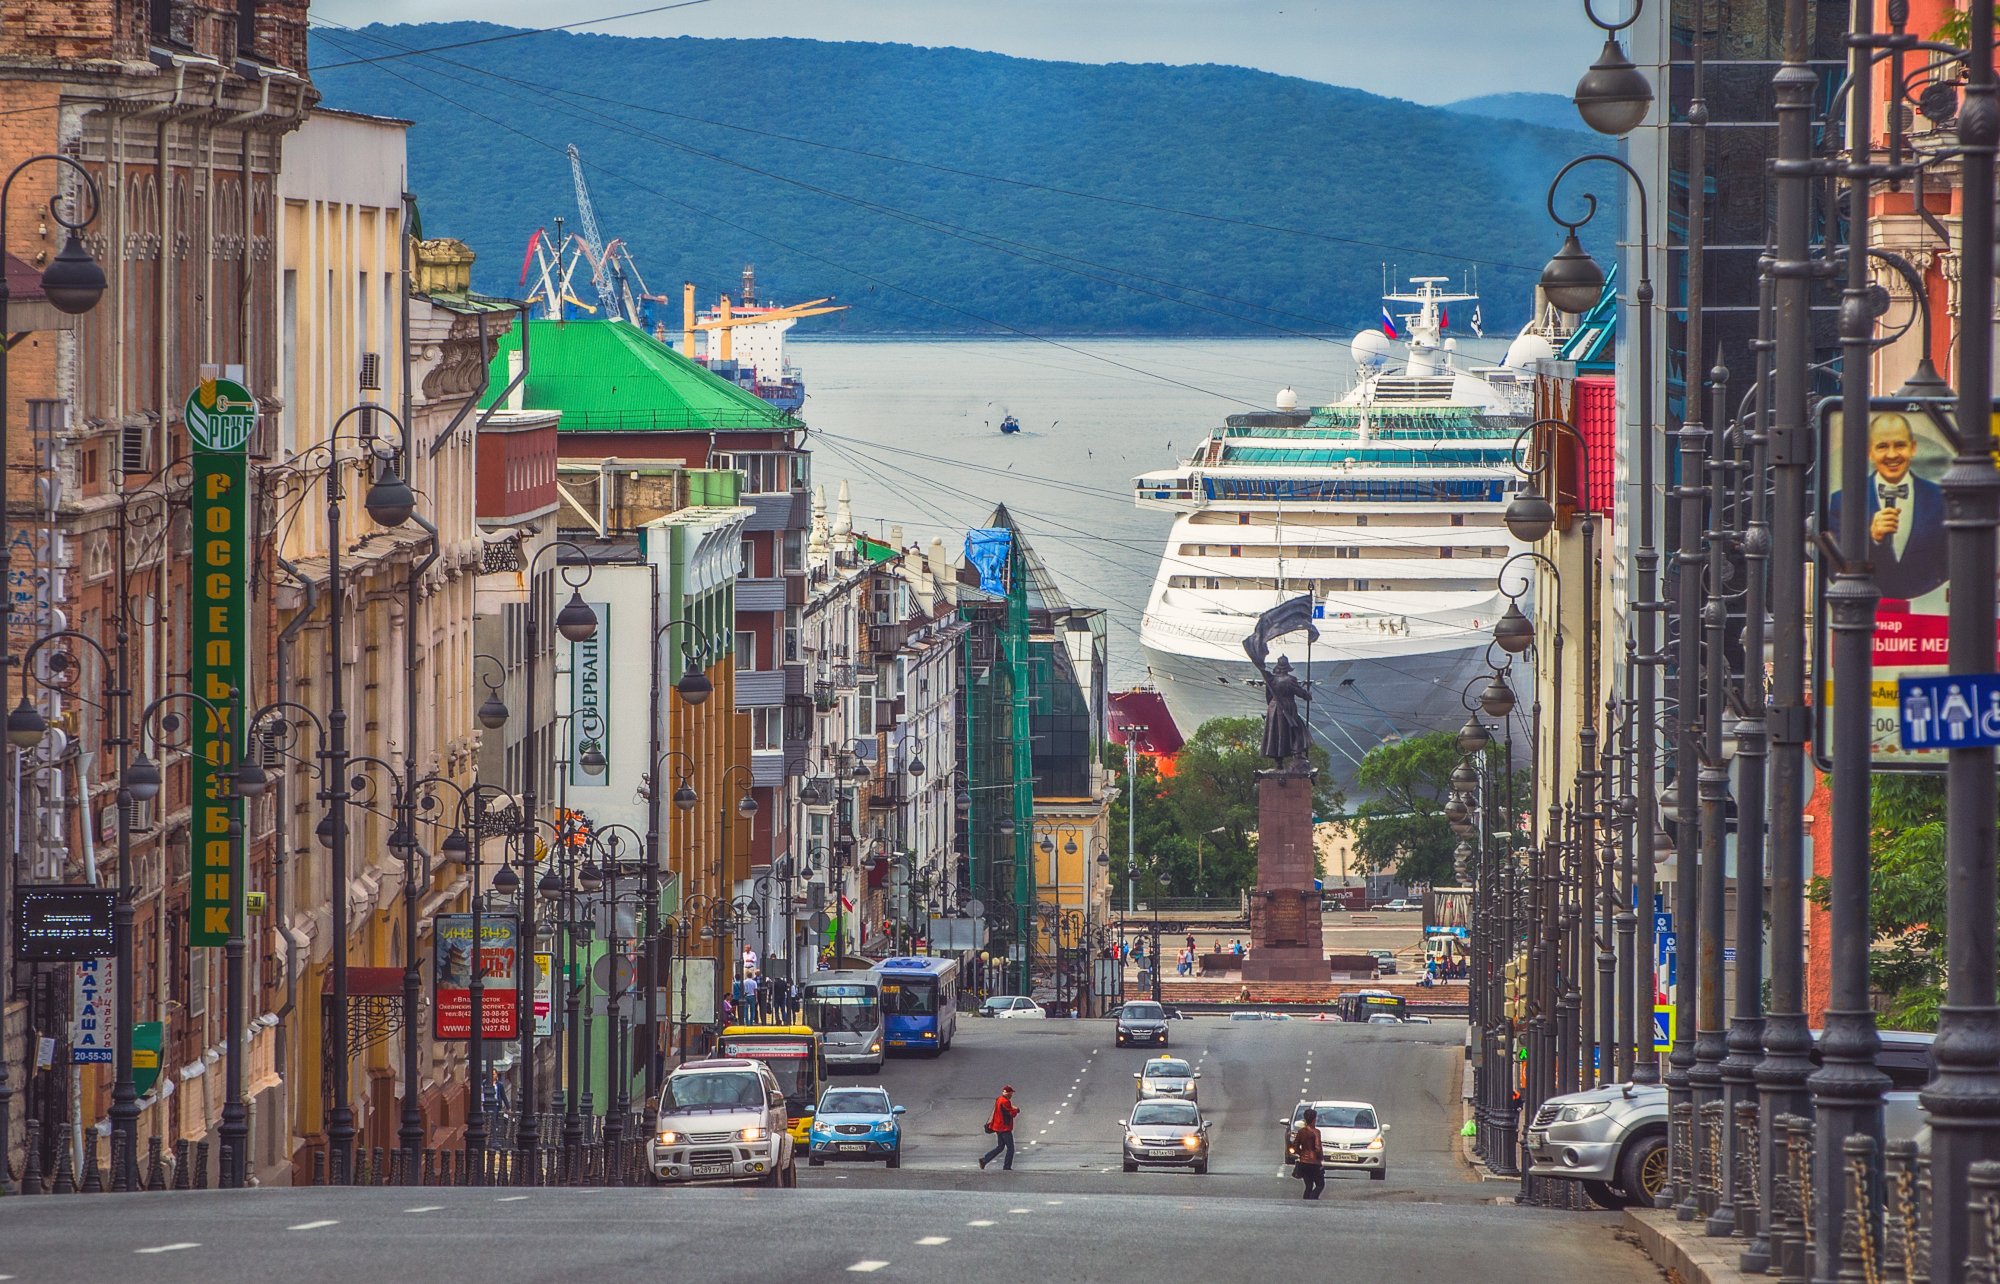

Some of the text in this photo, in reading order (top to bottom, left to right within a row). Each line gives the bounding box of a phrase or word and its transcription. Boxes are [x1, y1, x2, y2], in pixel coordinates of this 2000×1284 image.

[1873, 637, 1917, 652] ЬШИЕ
[81, 960, 98, 1045] НАТАША
[74, 1052, 112, 1061] 20-55-30
